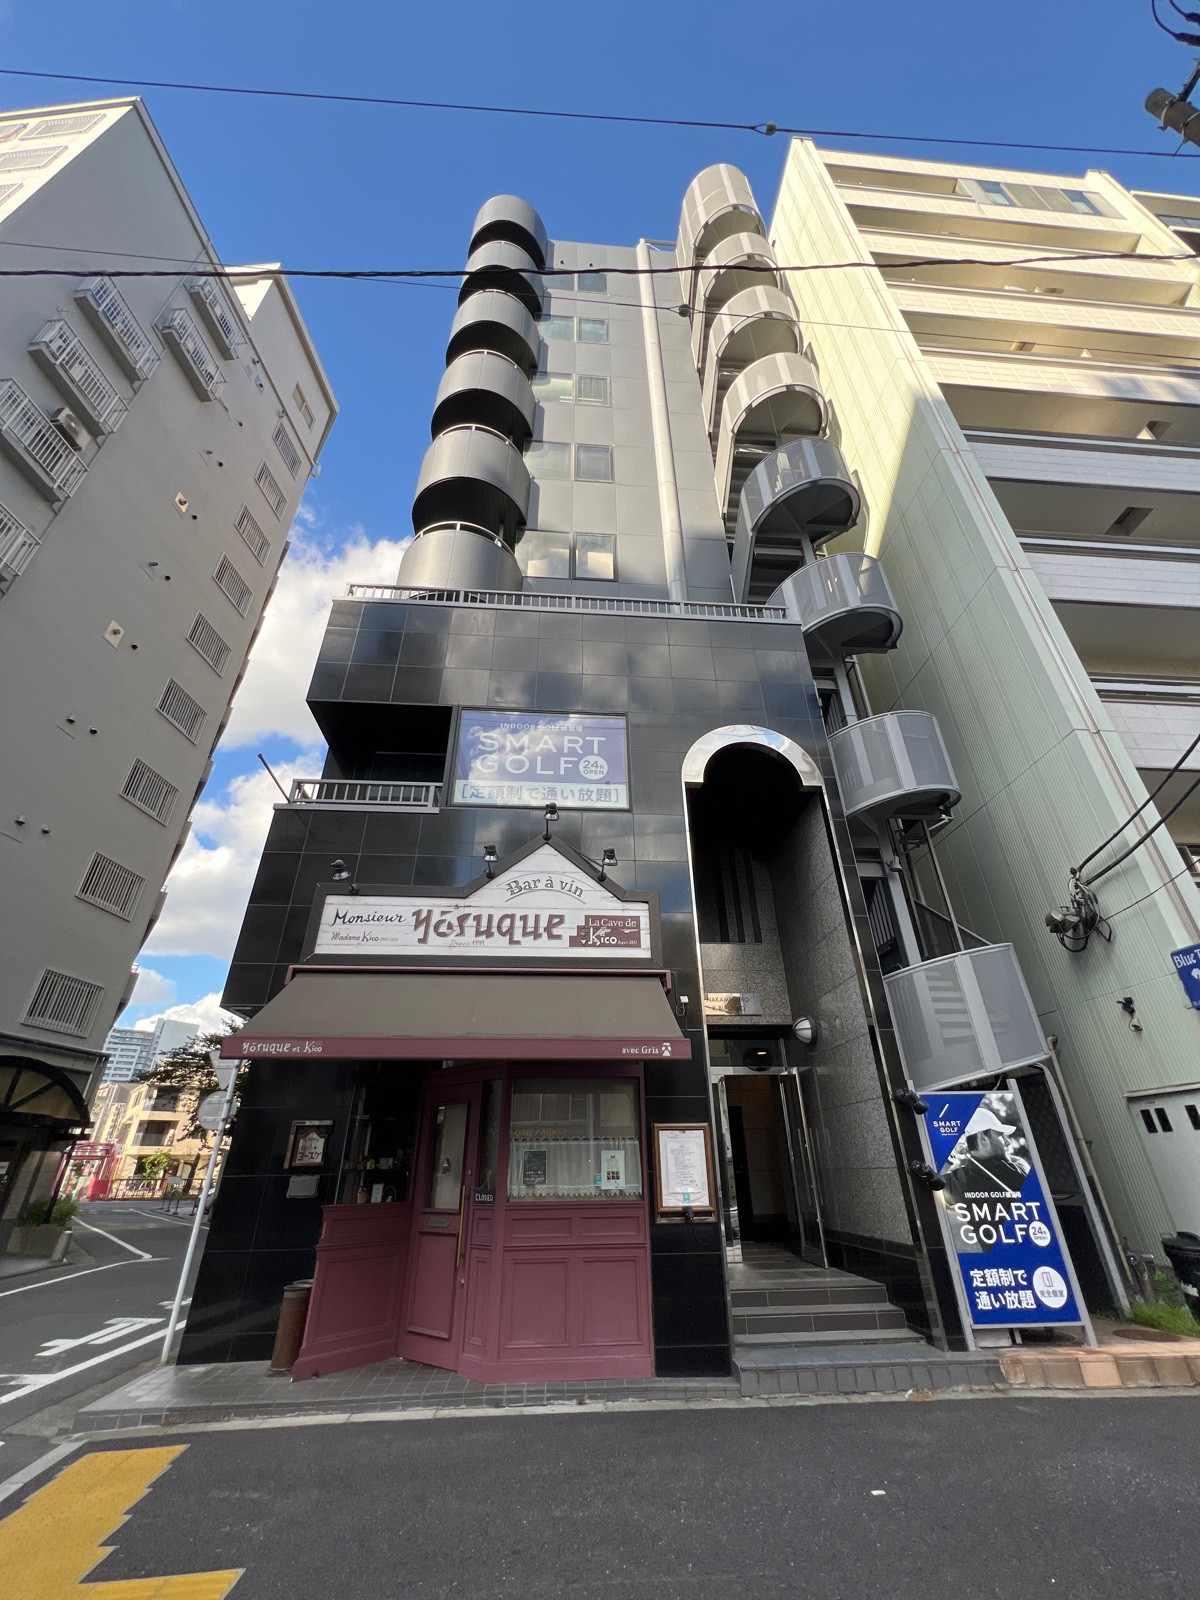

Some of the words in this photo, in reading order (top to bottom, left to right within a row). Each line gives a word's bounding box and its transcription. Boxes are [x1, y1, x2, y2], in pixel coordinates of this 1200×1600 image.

[500, 722, 536, 731] INDOOR
[477, 732, 606, 754] SMART
[475, 754, 578, 775] GOLF
[583, 760, 604, 770] 24h
[506, 877, 541, 896] Bar
[544, 876, 554, 888] à
[559, 880, 584, 898] vin
[331, 908, 406, 927] Monsieur
[588, 918, 600, 927] La
[600, 918, 624, 927] Cave
[625, 918, 637, 927] de
[331, 931, 360, 942] Madame
[361, 930, 379, 943] Kico
[1173, 953, 1197, 968] Blue
[292, 1045, 301, 1053] et
[303, 1040, 323, 1054] Kico
[621, 1046, 639, 1054] avec
[641, 1045, 659, 1054] Gris
[932, 1120, 961, 1128] SMART
[963, 1191, 989, 1199] INDOOR
[954, 1202, 1041, 1222] SMART
[960, 1223, 1029, 1244] GOLF
[1031, 1226, 1048, 1236] 24h
[969, 1268, 1028, 1288] 定額制で
[975, 1290, 1037, 1310] 通い放題
